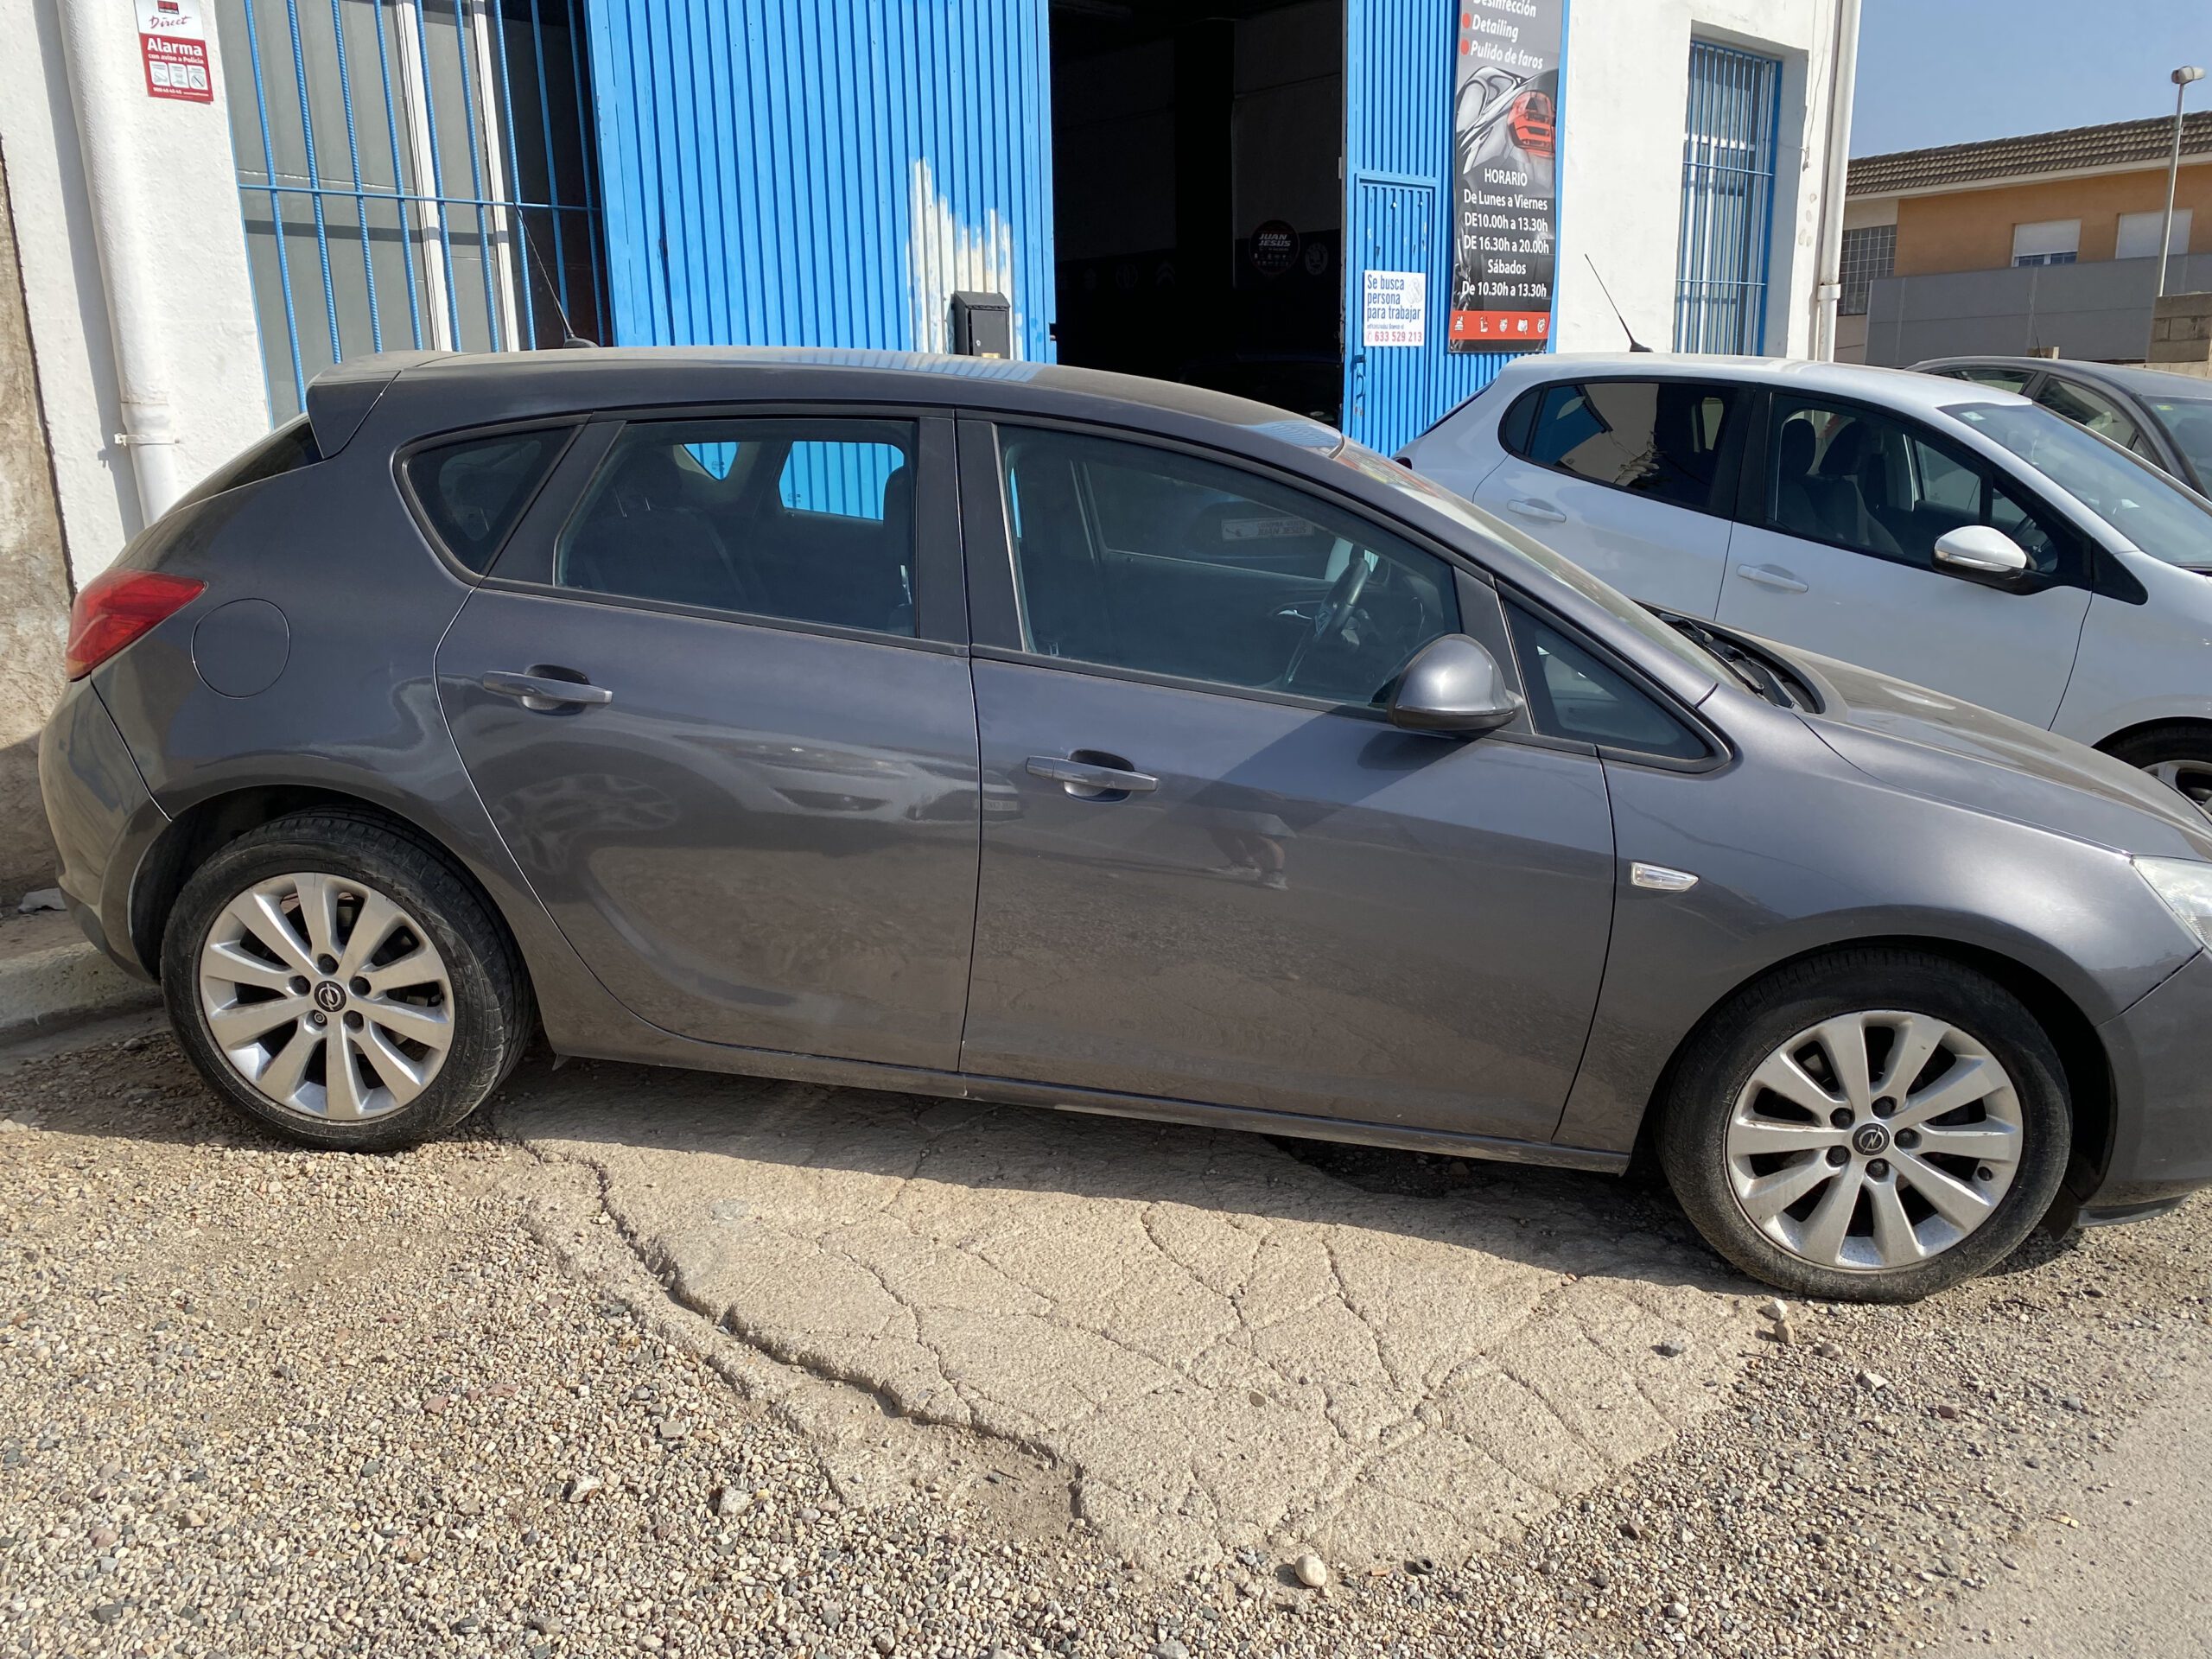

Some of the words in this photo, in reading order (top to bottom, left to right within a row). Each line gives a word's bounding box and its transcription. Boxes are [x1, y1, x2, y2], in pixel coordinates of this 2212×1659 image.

[1472, 0, 1536, 17] esinfección
[149, 16, 192, 29] Direct
[1471, 14, 1519, 42] Detailing
[147, 37, 203, 56] Alarma
[1470, 40, 1503, 61] Pulido
[1504, 47, 1517, 64] de
[1518, 49, 1543, 69] faros
[1484, 168, 1528, 187] HORARIO
[1464, 188, 1478, 204] De
[1478, 190, 1506, 207] Lunes
[1507, 197, 1513, 207] a
[1514, 194, 1548, 211] Viernes
[1510, 219, 1516, 230] a
[1518, 217, 1548, 232] 13.30h
[1464, 235, 1478, 250] DE
[1479, 236, 1510, 251] 16.30h
[1512, 241, 1518, 252] a
[1519, 238, 1549, 254] 20.00h
[1487, 258, 1527, 275] Sábados
[1367, 274, 1378, 289] Se
[1380, 275, 1405, 290] busca
[1462, 280, 1476, 296] De
[1478, 281, 1509, 296] 10.30h
[1510, 286, 1516, 296] a
[1518, 283, 1547, 297] 13.30h
[1367, 292, 1401, 307] persona
[1367, 307, 1386, 321] para
[1389, 305, 1421, 322] trabajar
[1375, 331, 1389, 342] 633
[1391, 331, 1406, 342] 529
[1408, 331, 1422, 342] 213
